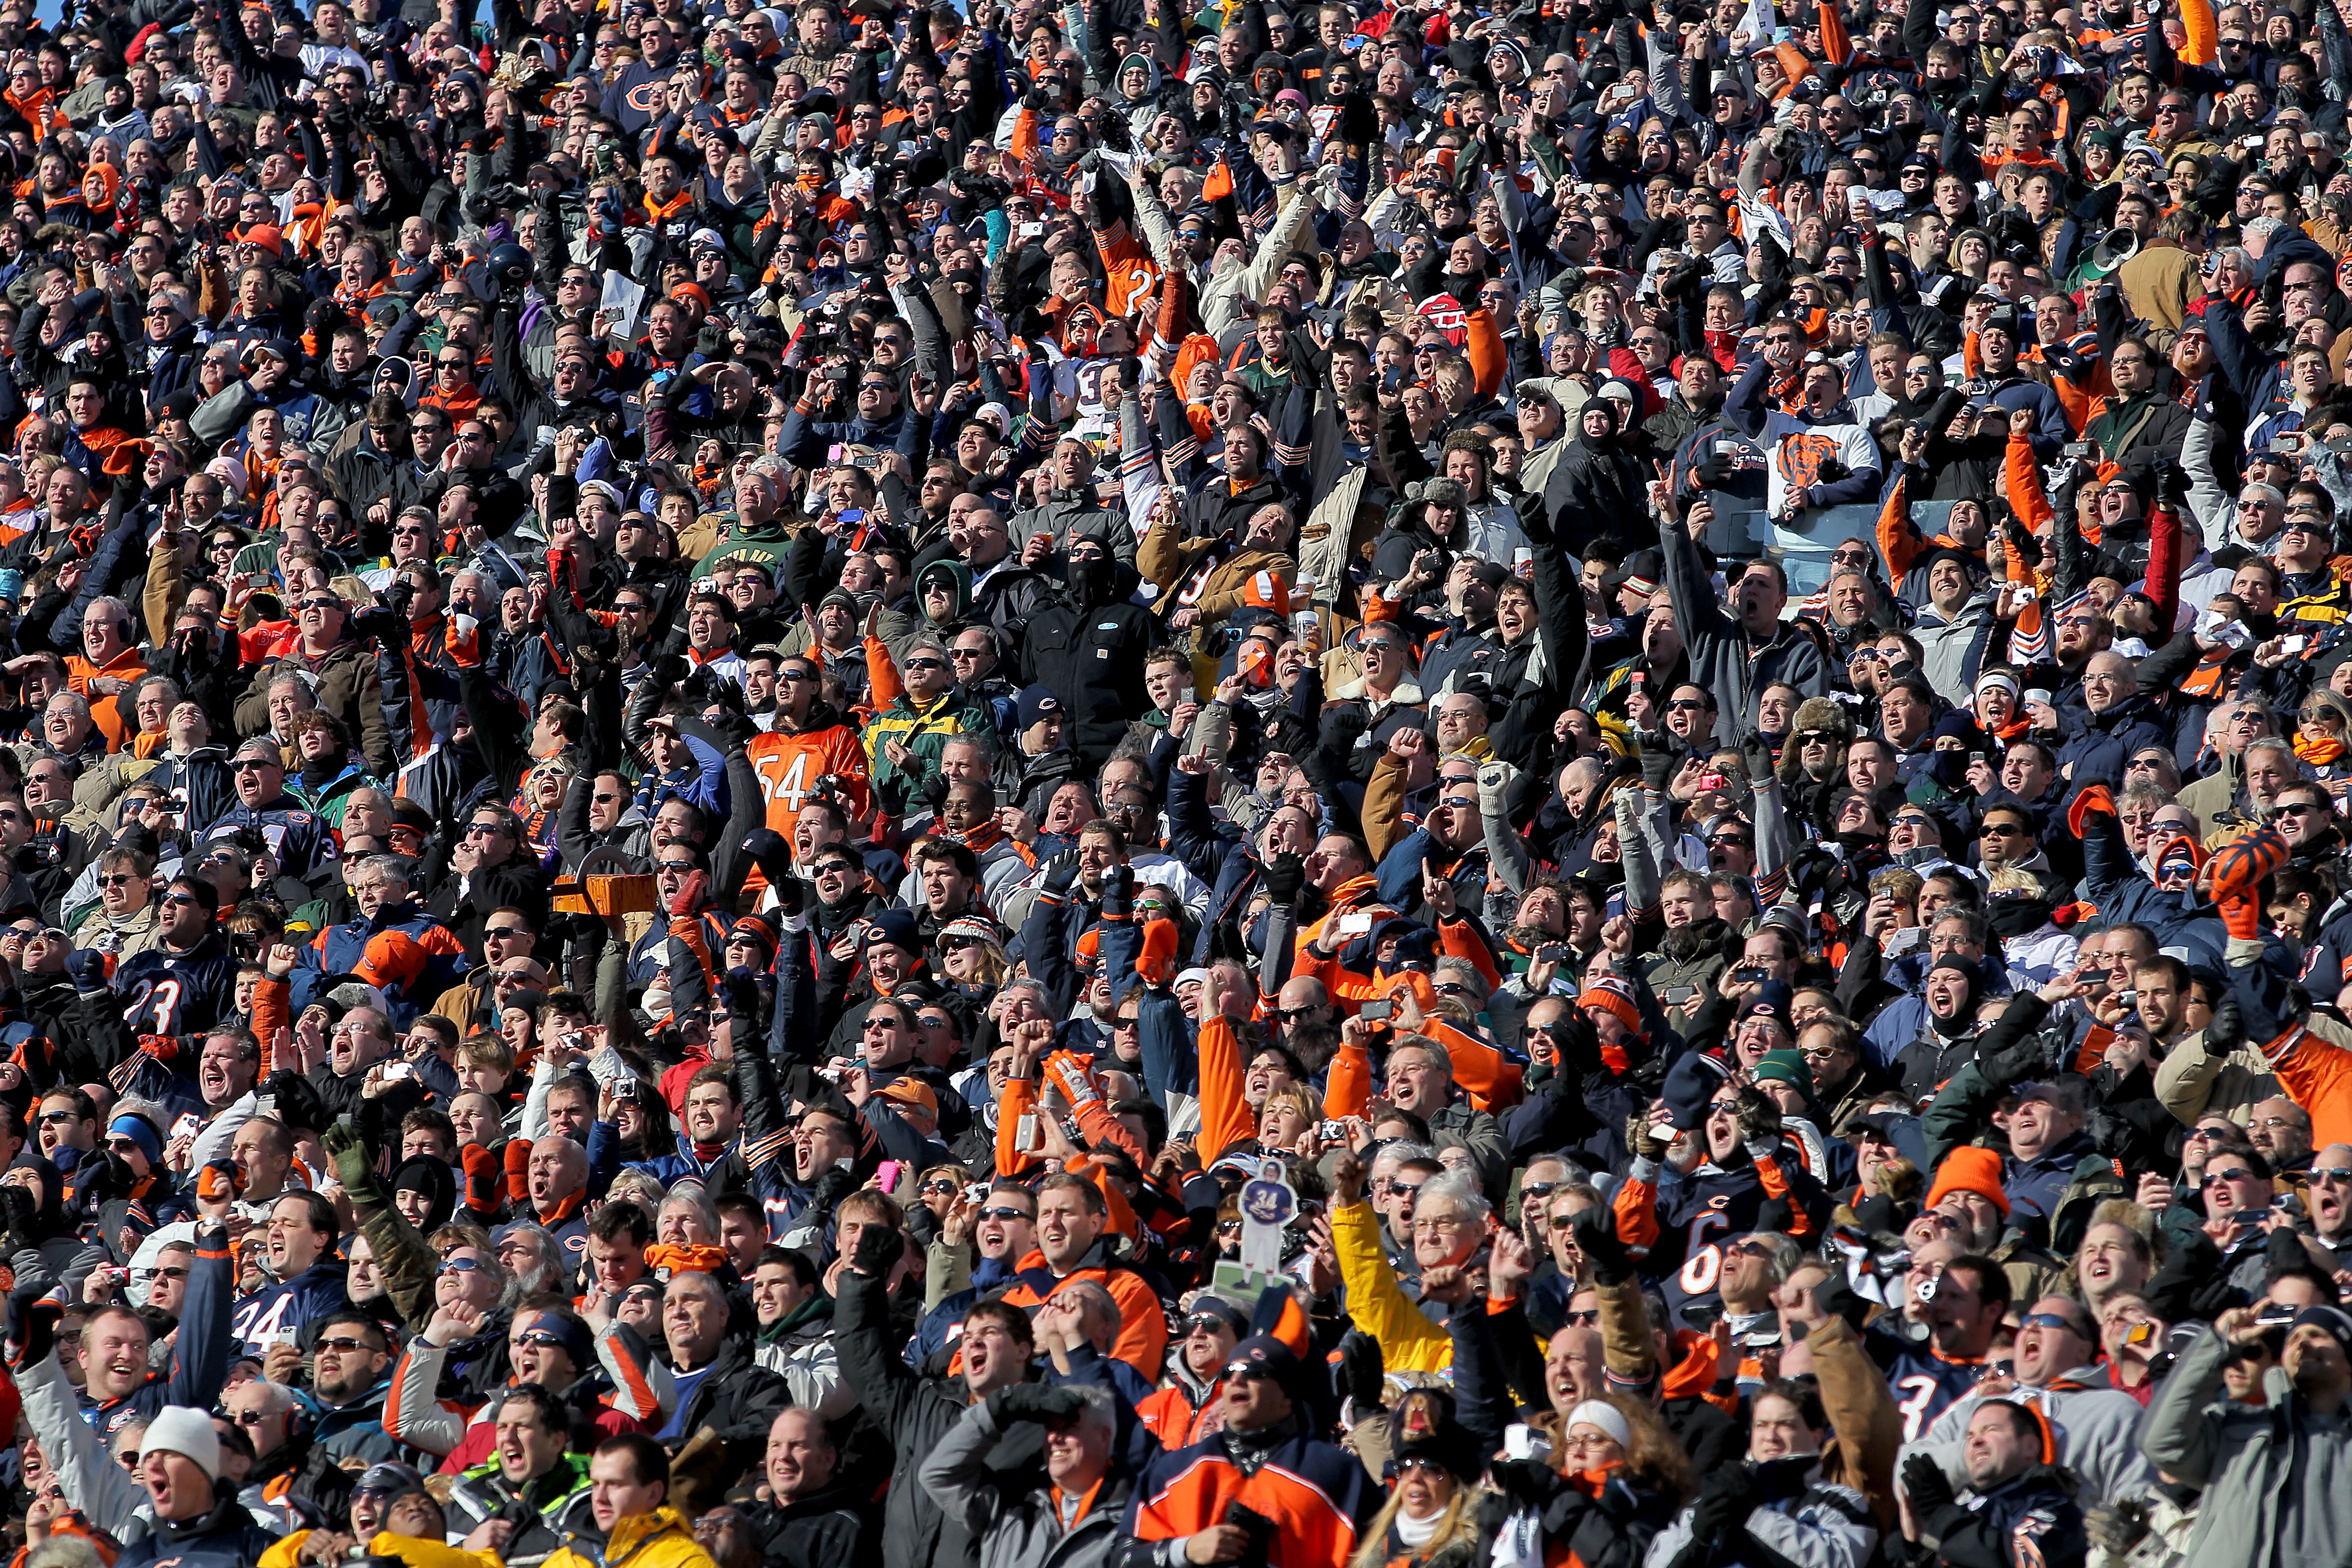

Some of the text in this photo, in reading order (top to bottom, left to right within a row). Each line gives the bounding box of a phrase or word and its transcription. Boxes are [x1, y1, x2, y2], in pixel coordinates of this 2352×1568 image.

[1125, 269, 1156, 317] 2
[2181, 684, 2209, 694] ARS
[1039, 698, 1056, 709] C
[756, 753, 808, 812] 54
[868, 927, 885, 941] C
[123, 979, 180, 1035] 23
[1752, 1004, 1774, 1014] C
[1257, 1190, 1278, 1209] 34
[1707, 1195, 1730, 1209] C
[1679, 1210, 1730, 1295] 6
[232, 1293, 294, 1353] 34
